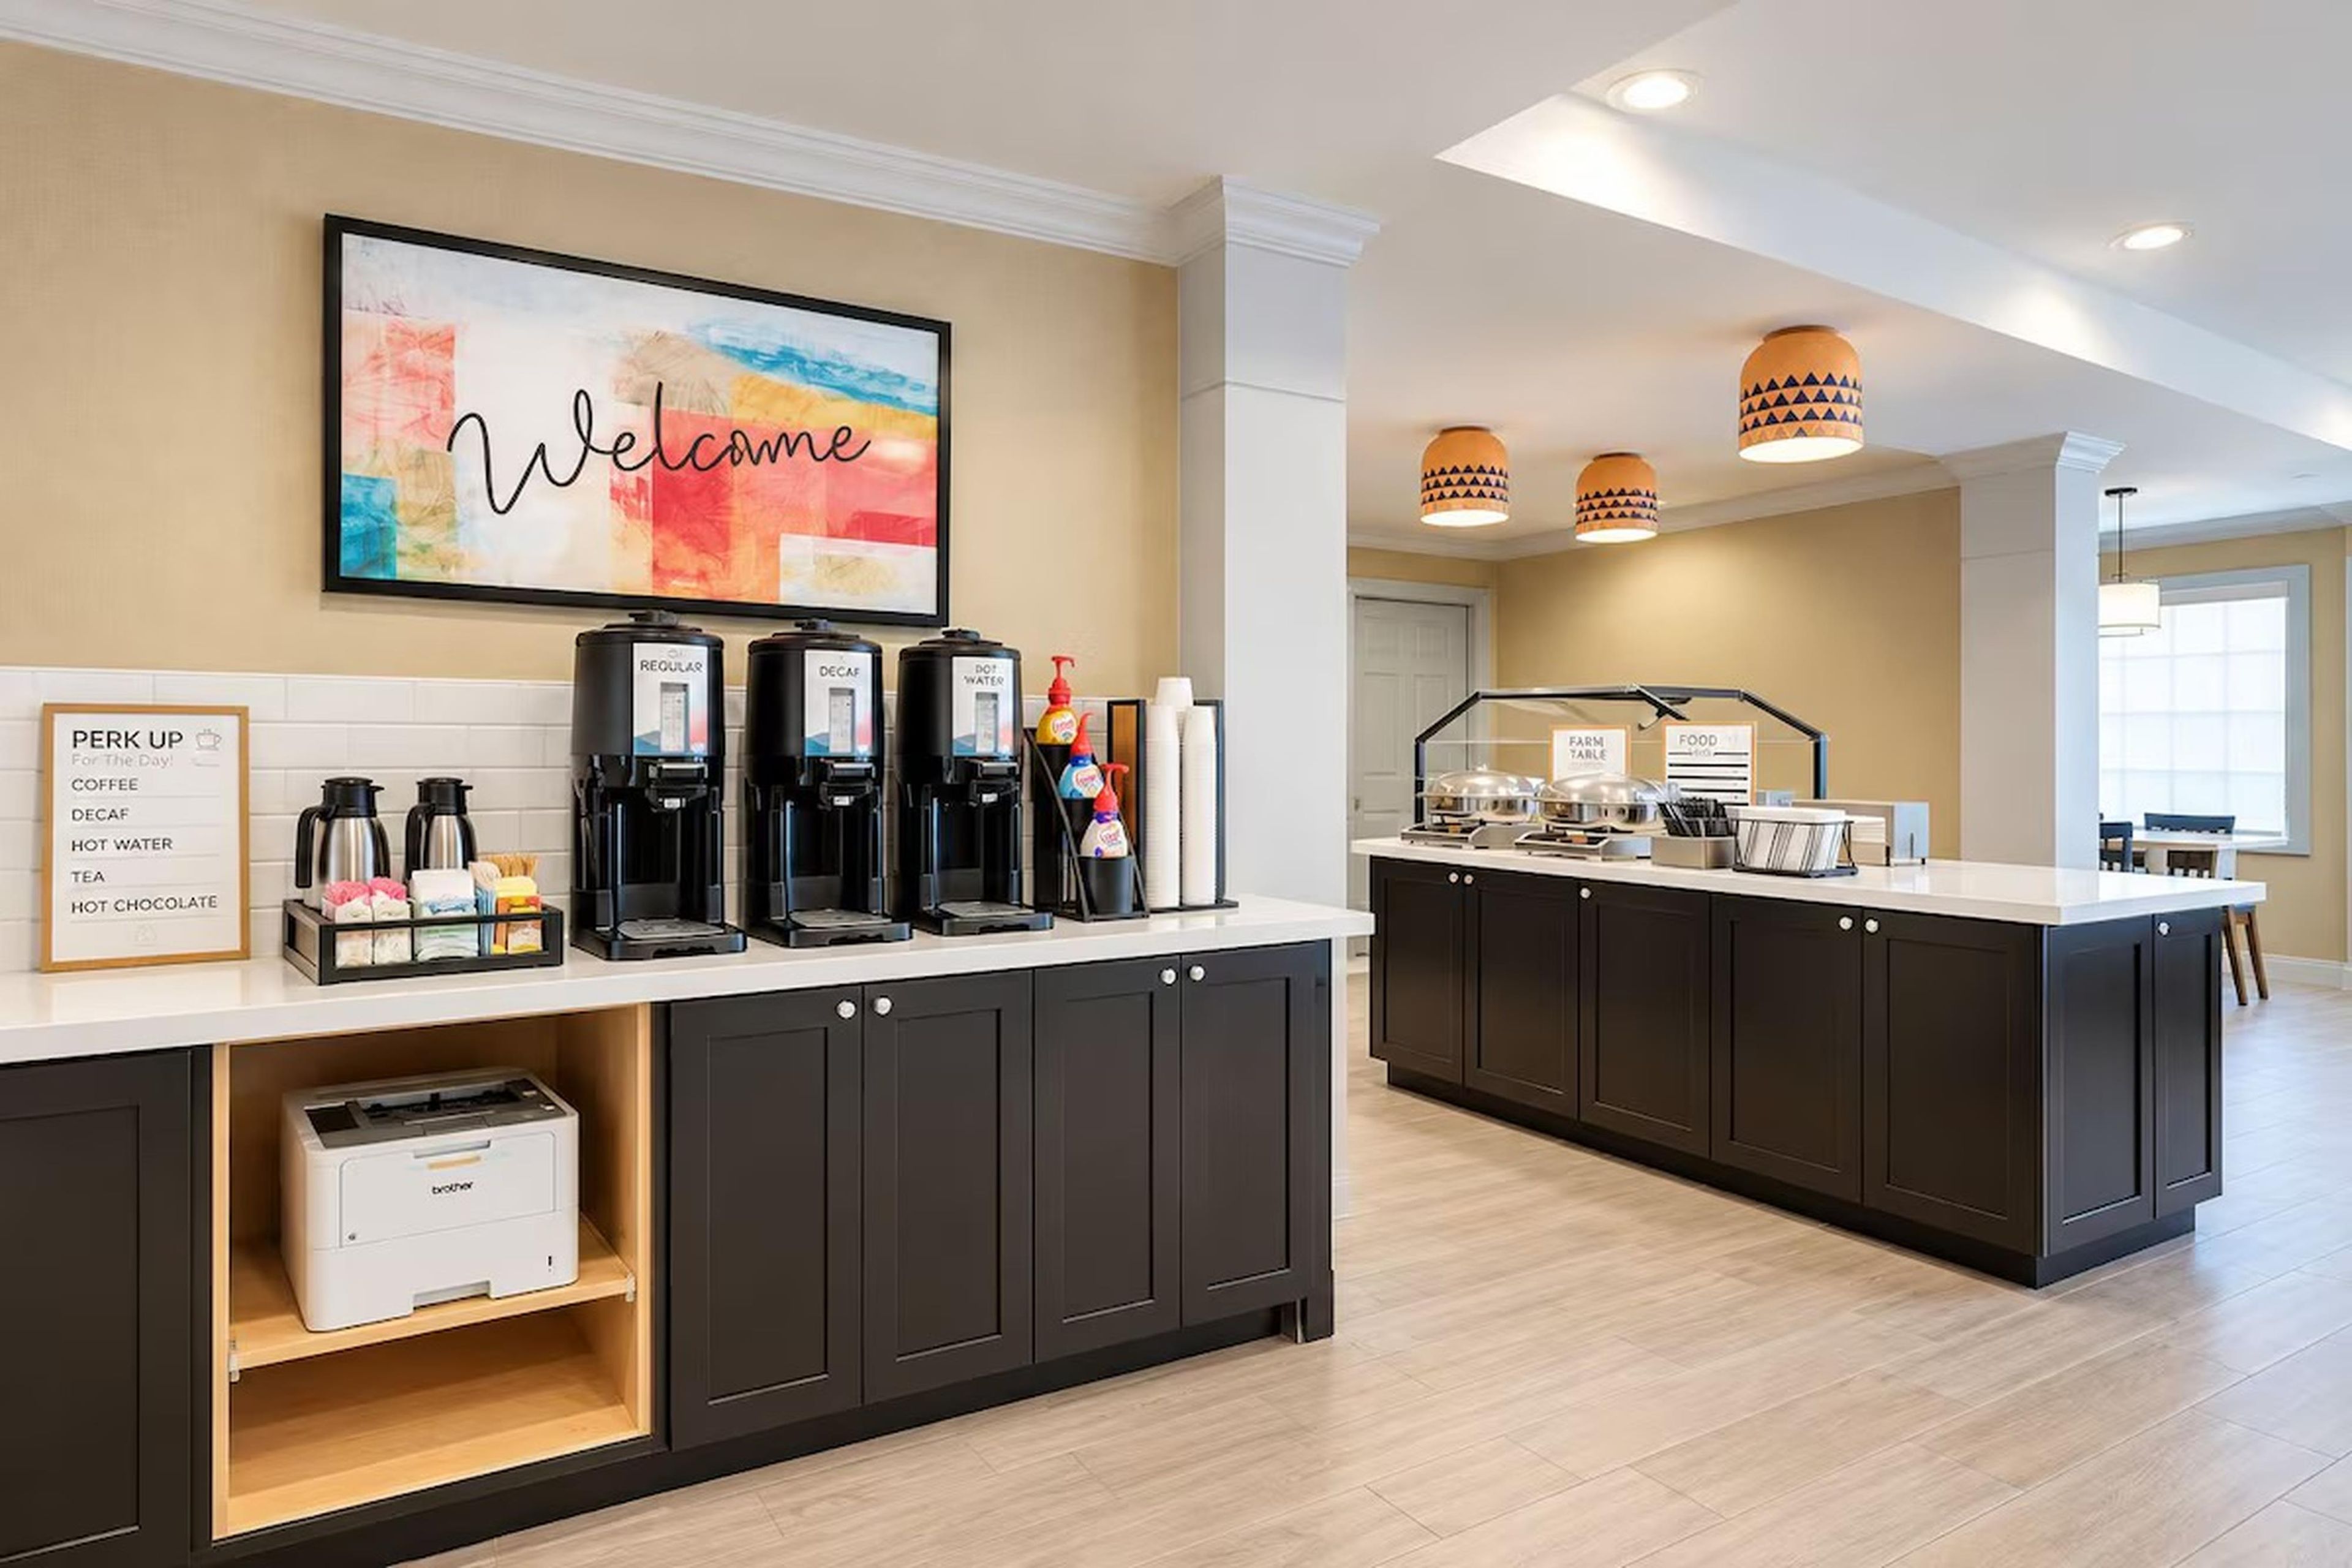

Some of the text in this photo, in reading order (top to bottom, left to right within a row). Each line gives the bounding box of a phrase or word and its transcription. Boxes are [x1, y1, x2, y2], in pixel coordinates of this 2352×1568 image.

[447, 381, 872, 515] Welcome
[640, 659, 703, 673] REGULAR
[819, 665, 860, 677] DECAF
[964, 676, 1005, 687] WATER
[73, 730, 184, 749] PERK UP
[1569, 736, 1604, 747] FARM
[1679, 734, 1718, 747] FOOD
[72, 753, 174, 769] For The Day!
[71, 778, 138, 791] COFFEE
[71, 808, 130, 822] DECAF
[71, 837, 173, 852] HOT WATER
[70, 870, 105, 883] TEA
[71, 895, 218, 914] HOT CHOCOLATE
[432, 1181, 473, 1194] brother
